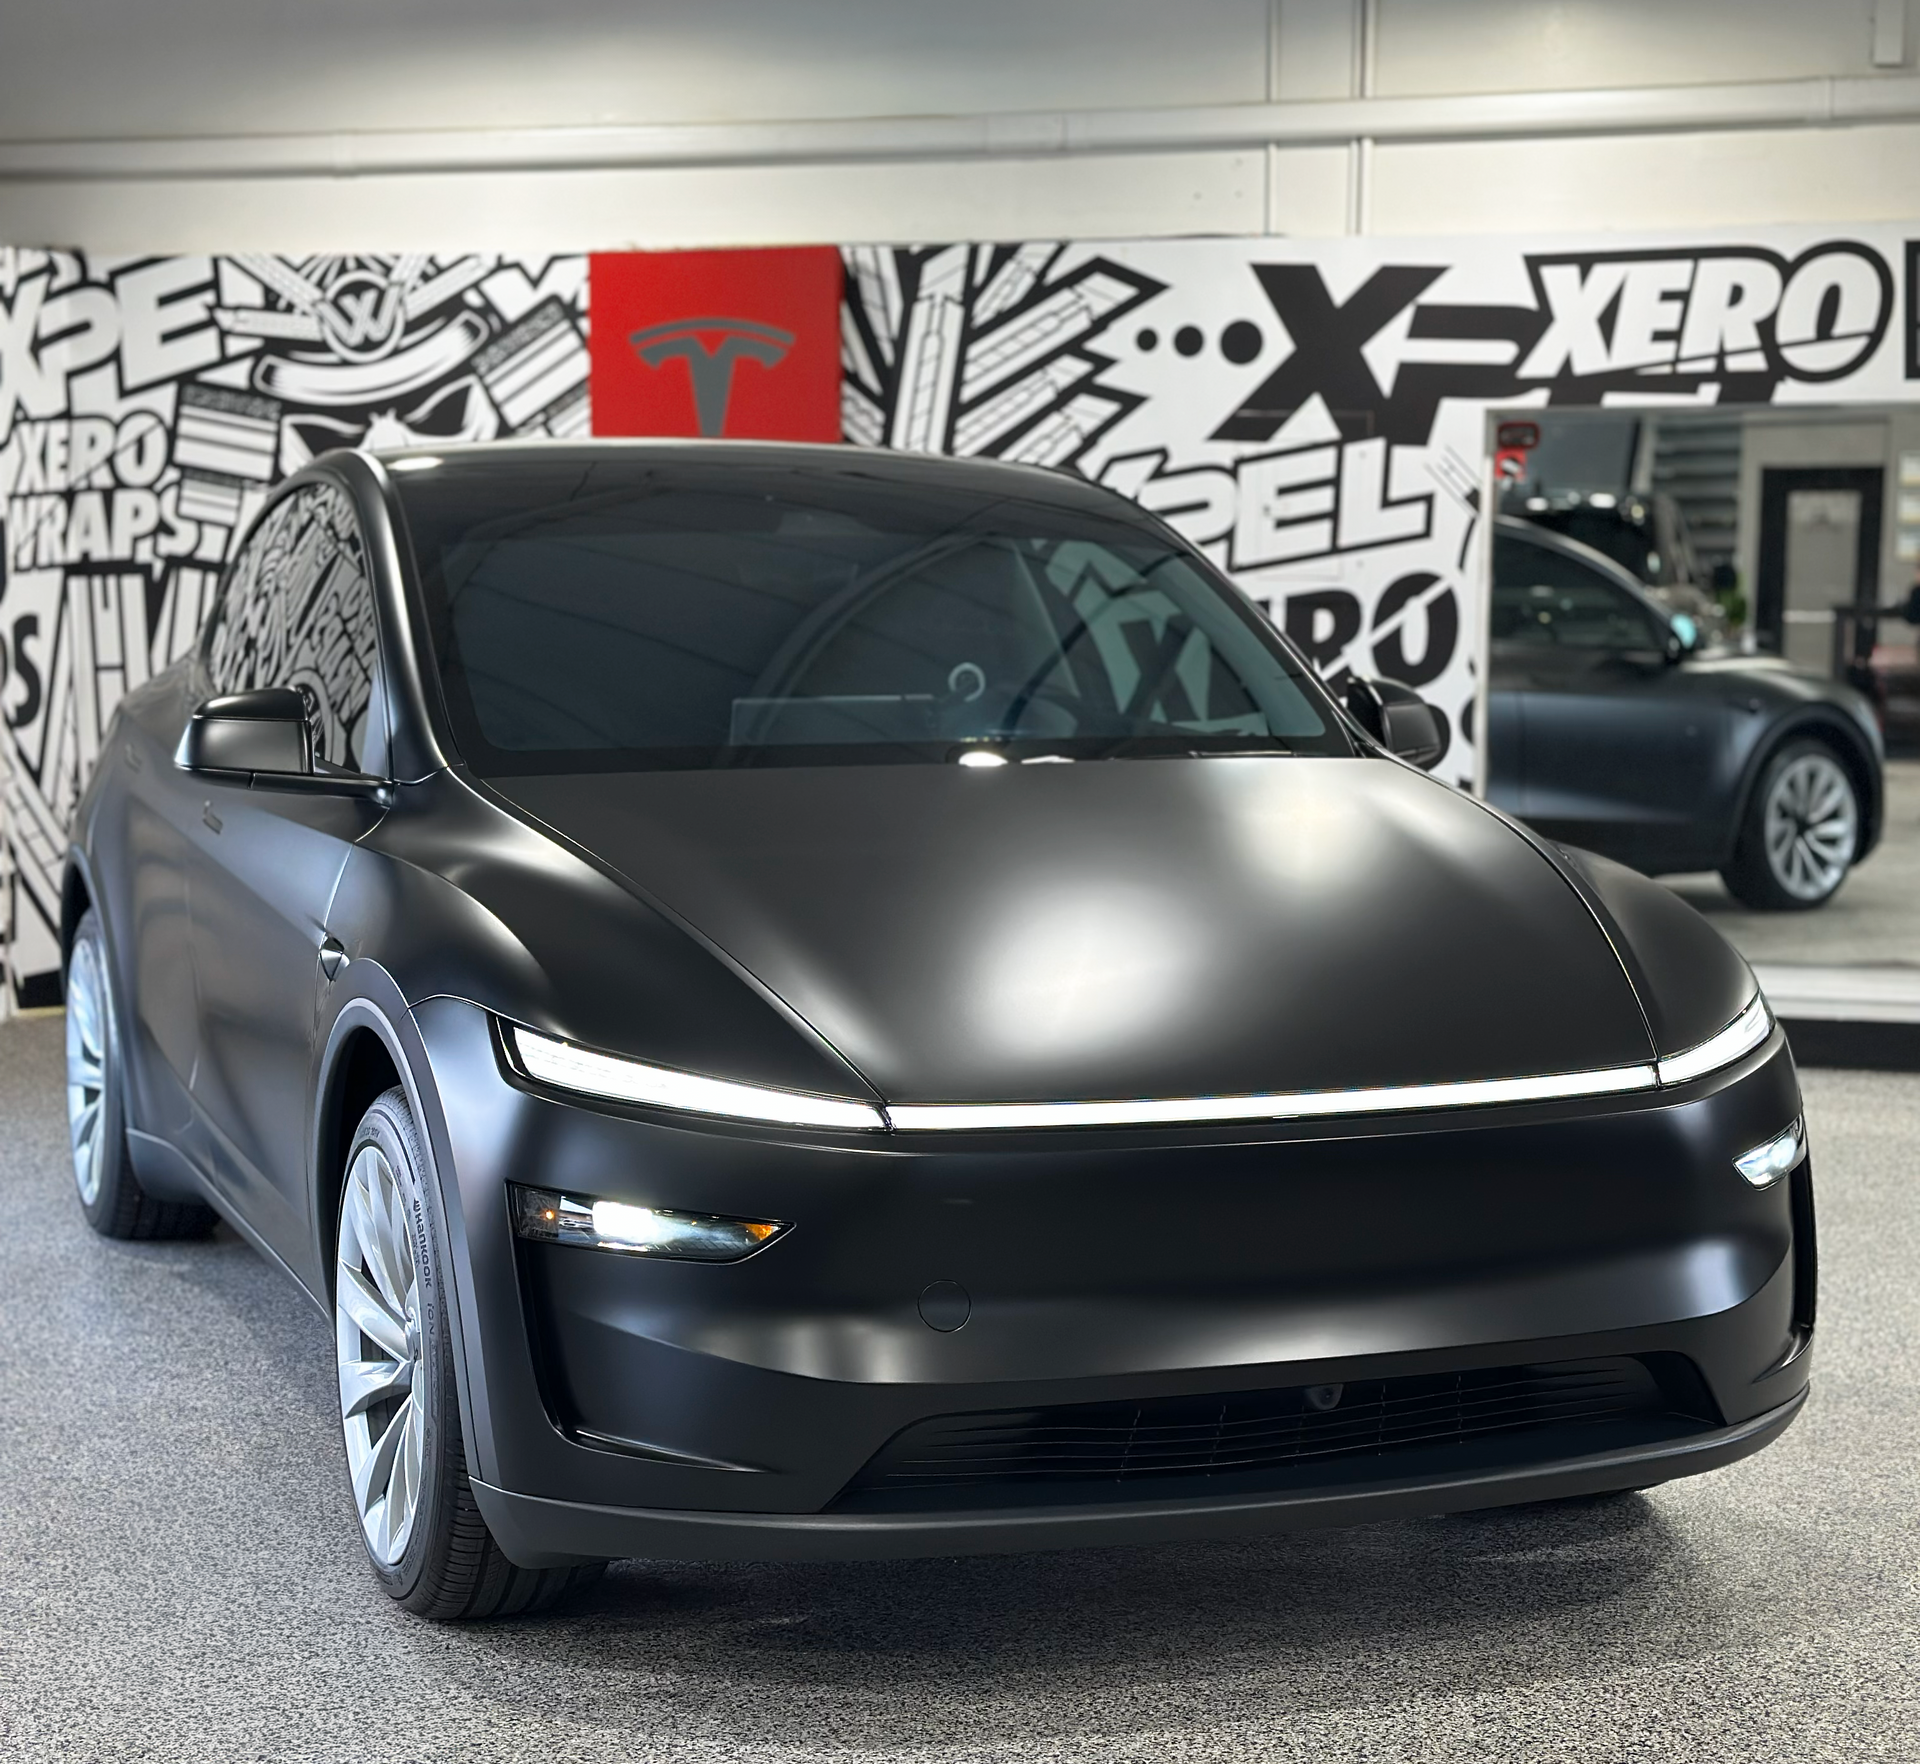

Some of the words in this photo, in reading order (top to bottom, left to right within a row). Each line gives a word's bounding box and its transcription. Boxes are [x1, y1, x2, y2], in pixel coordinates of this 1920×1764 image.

[1514, 240, 1895, 384] XERO
[14, 409, 171, 492] XERO
[1097, 437, 1434, 574] PEL
[8, 482, 202, 575] WRAPS
